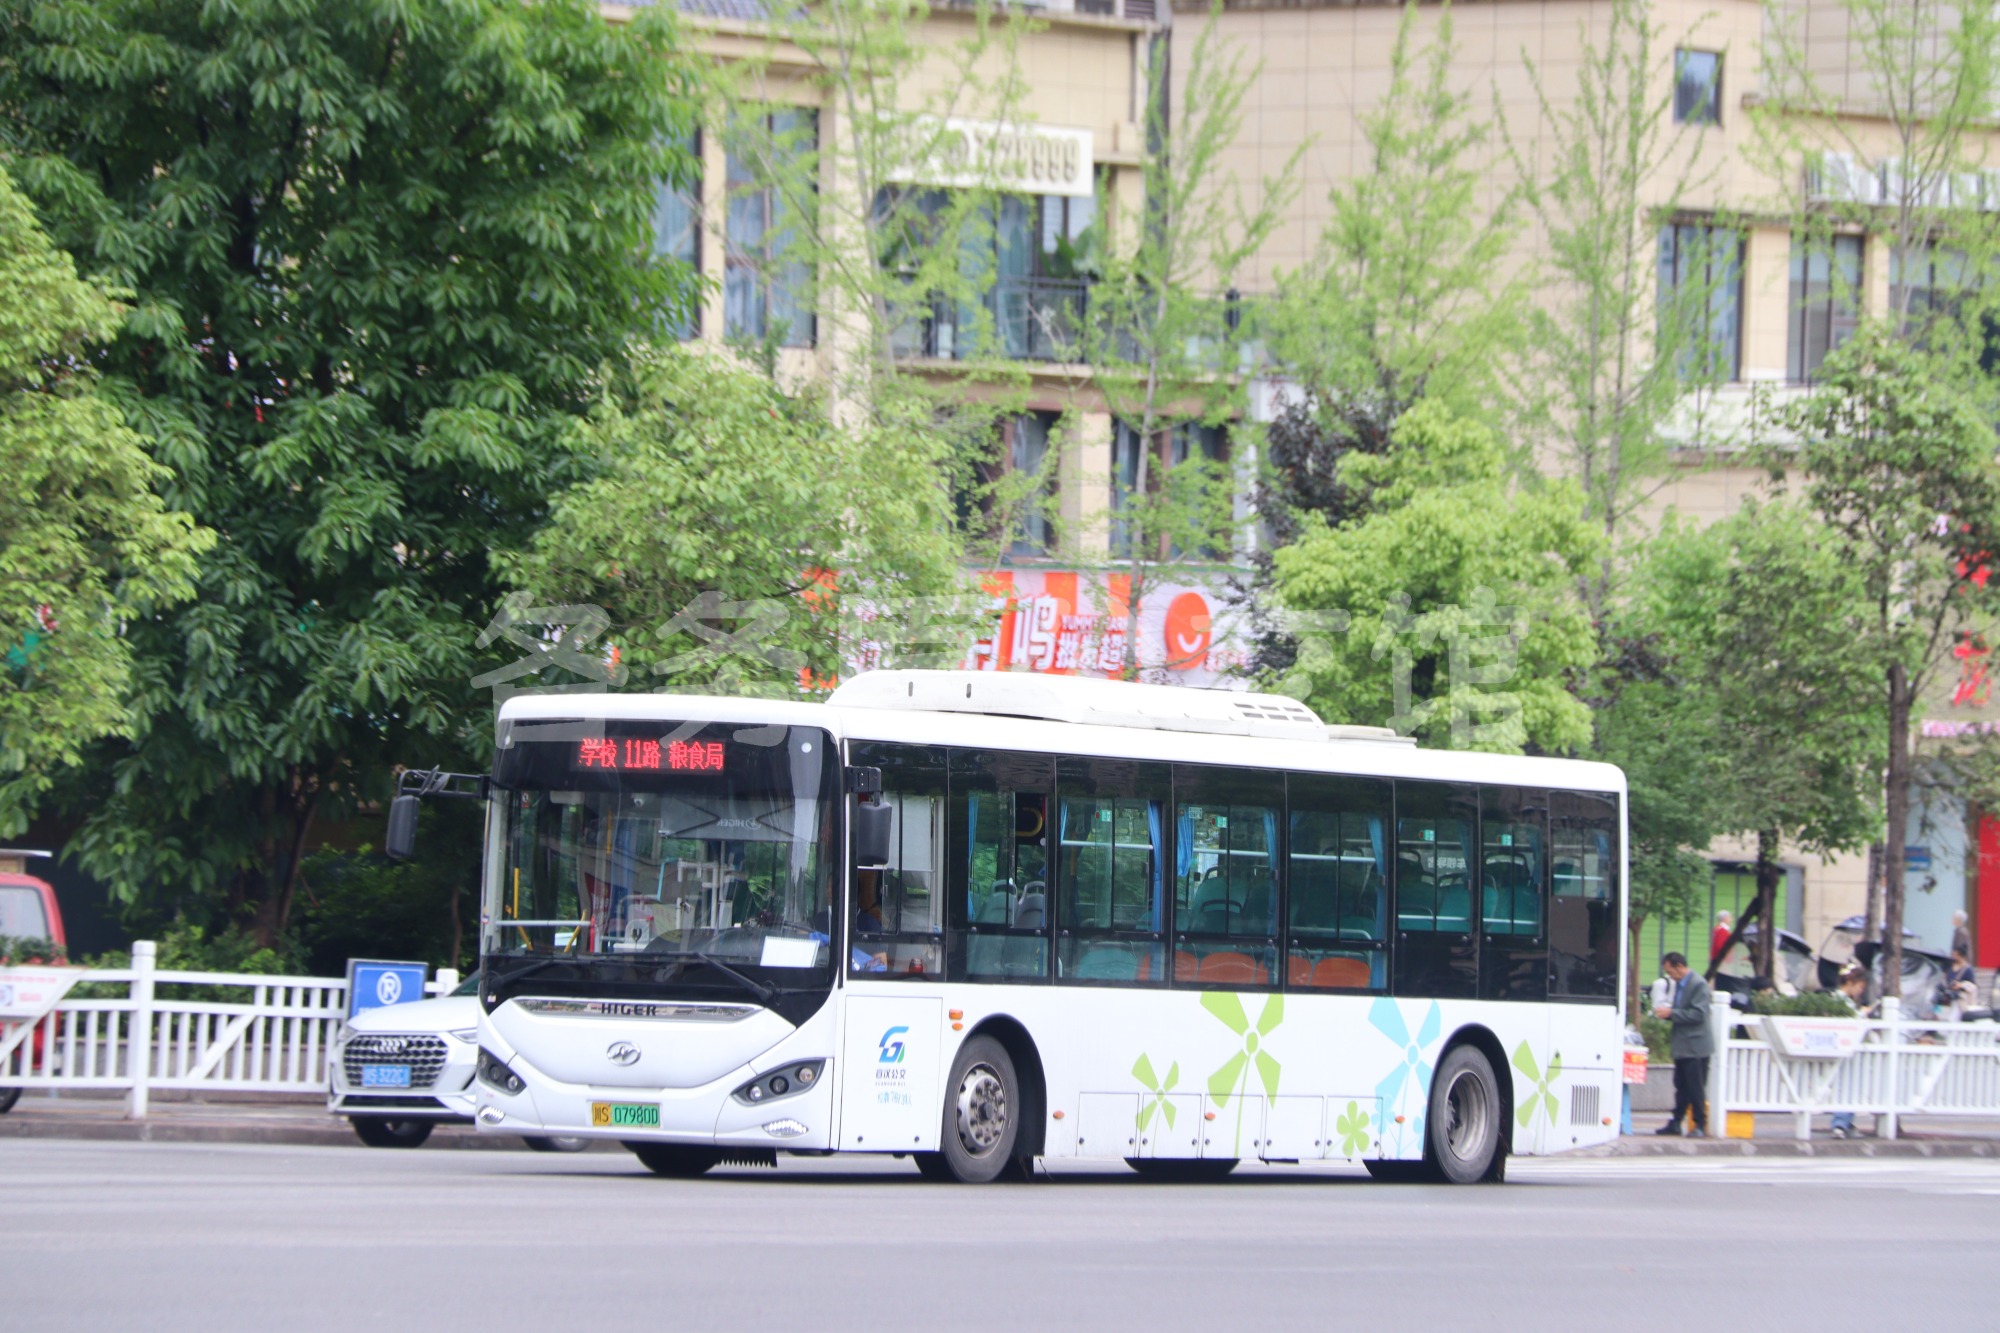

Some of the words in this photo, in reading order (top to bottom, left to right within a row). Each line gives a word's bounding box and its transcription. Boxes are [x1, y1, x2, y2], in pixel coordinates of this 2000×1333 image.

[579, 739, 617, 768] 学校
[625, 740, 661, 769] 11路
[669, 741, 724, 770] 粮食局
[601, 1003, 657, 1016] HIGER
